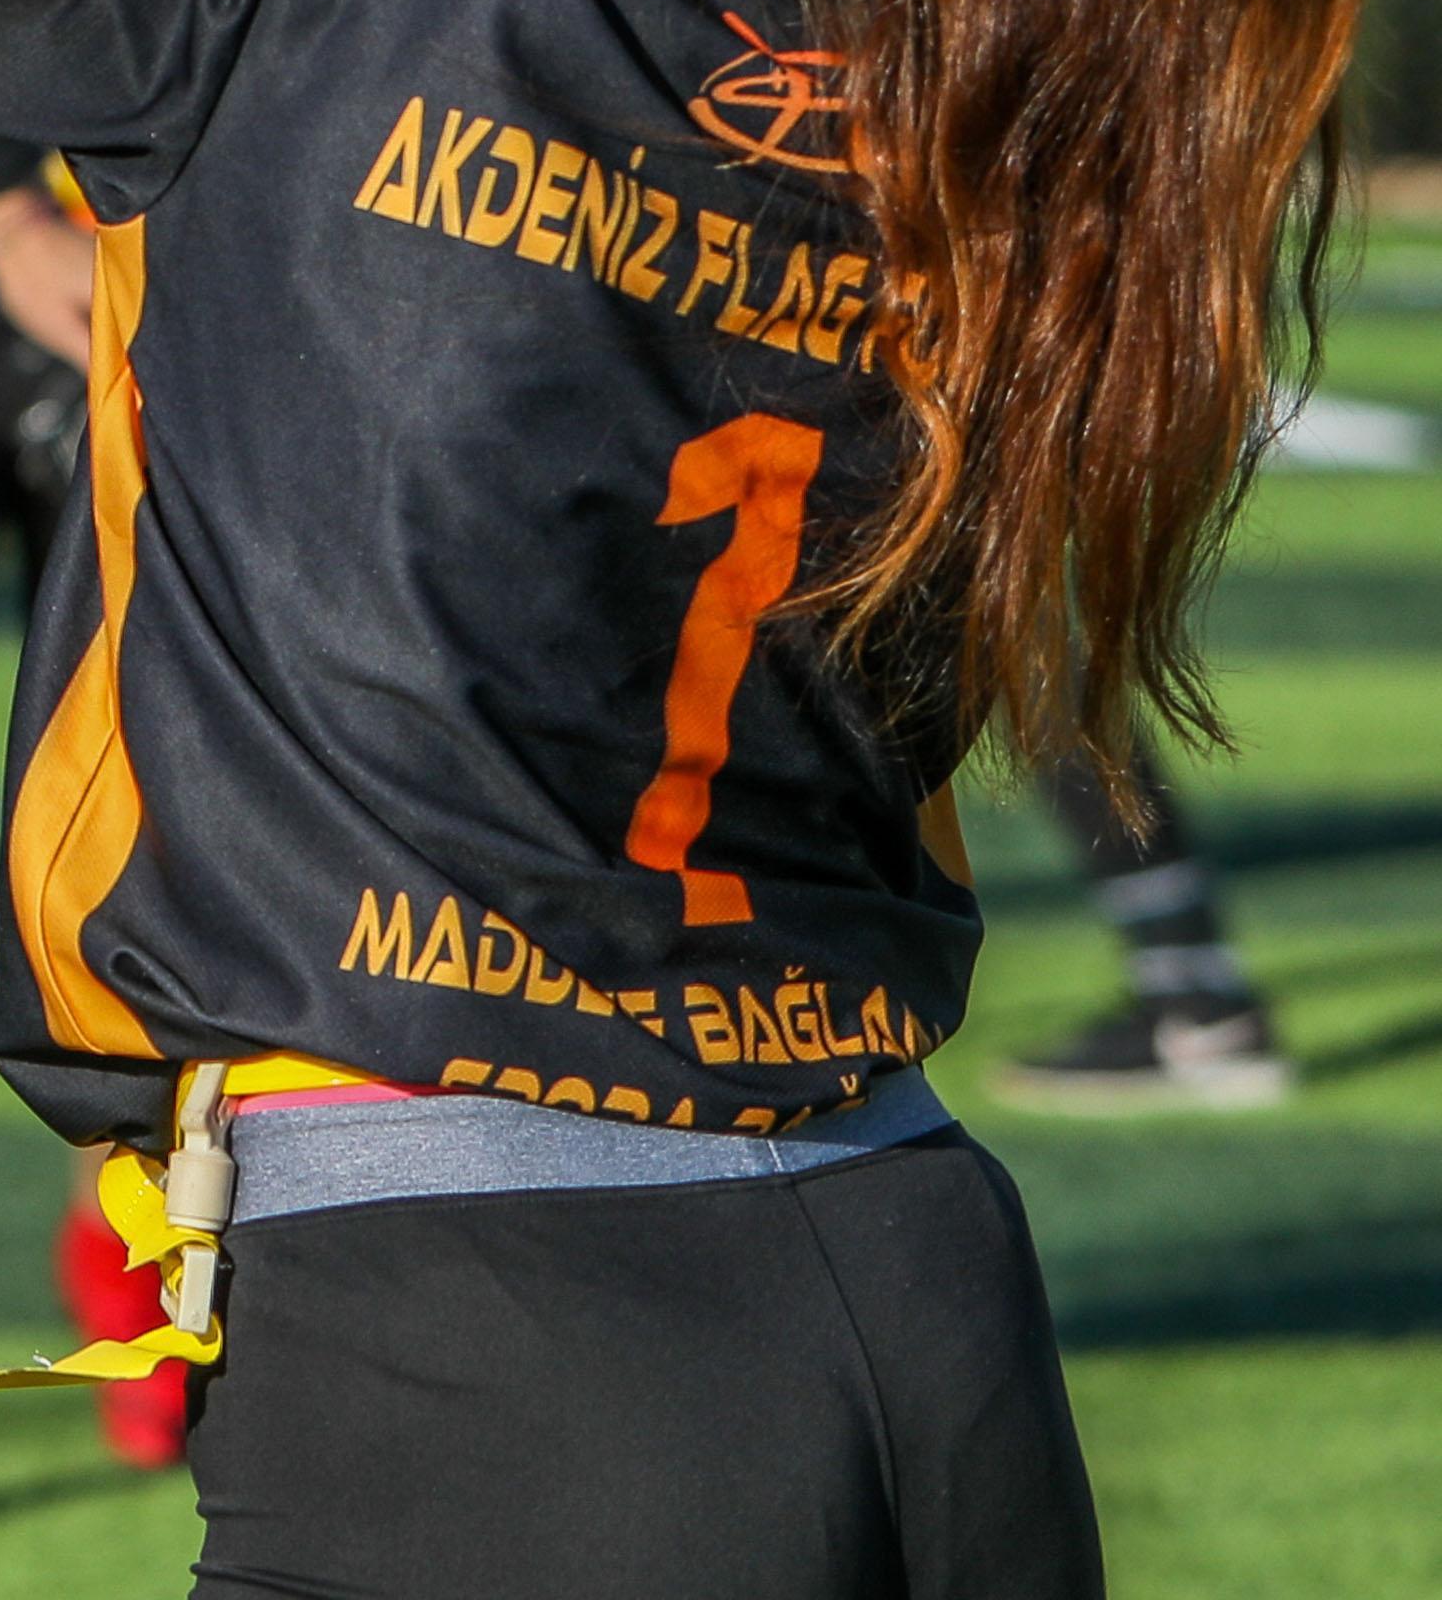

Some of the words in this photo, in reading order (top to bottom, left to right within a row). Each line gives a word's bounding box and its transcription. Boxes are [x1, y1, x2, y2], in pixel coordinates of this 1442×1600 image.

[354, 96, 679, 302] AKDENİZ
[675, 209, 871, 363] FLAG
[625, 412, 825, 927] 1
